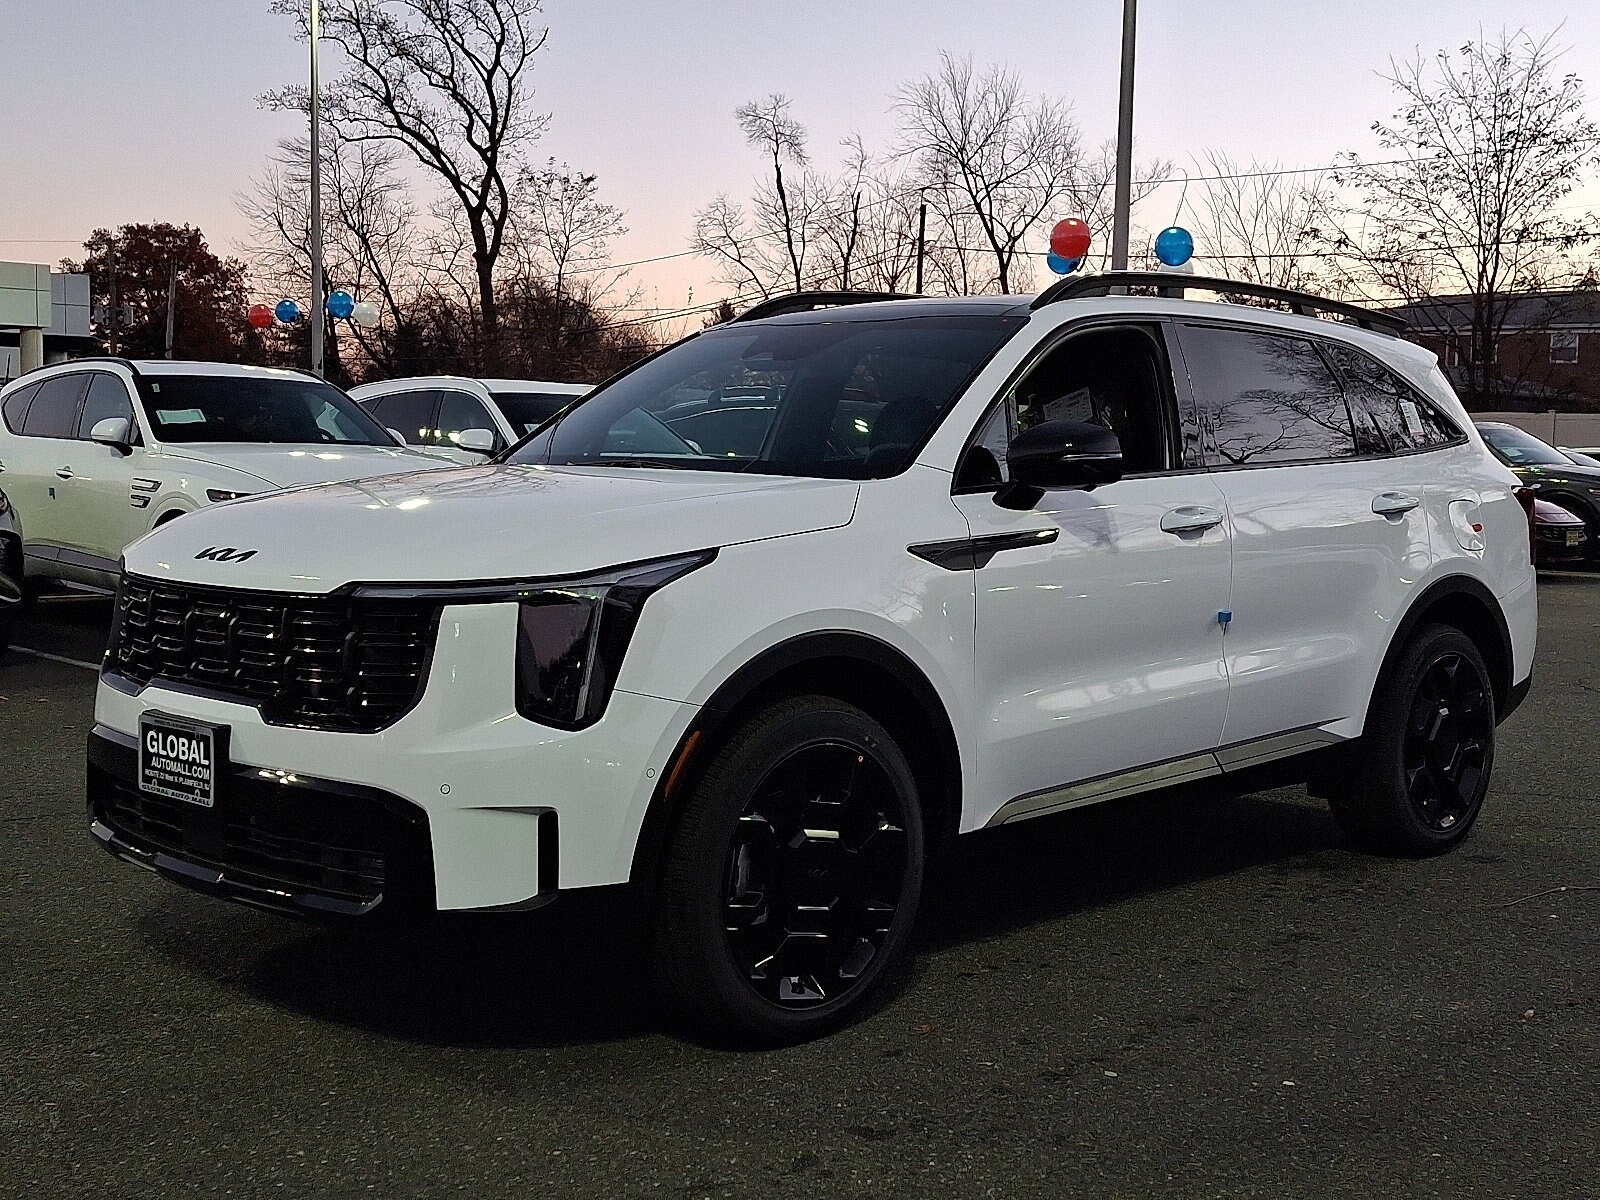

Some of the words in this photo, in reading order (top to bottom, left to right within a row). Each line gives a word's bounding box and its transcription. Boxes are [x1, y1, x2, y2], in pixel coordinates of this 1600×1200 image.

[146, 731, 210, 765] GLOBAL
[151, 756, 210, 780] AUTOMALL.COM
[141, 784, 170, 794] GLOBAL
[170, 791, 190, 800] AUTO
